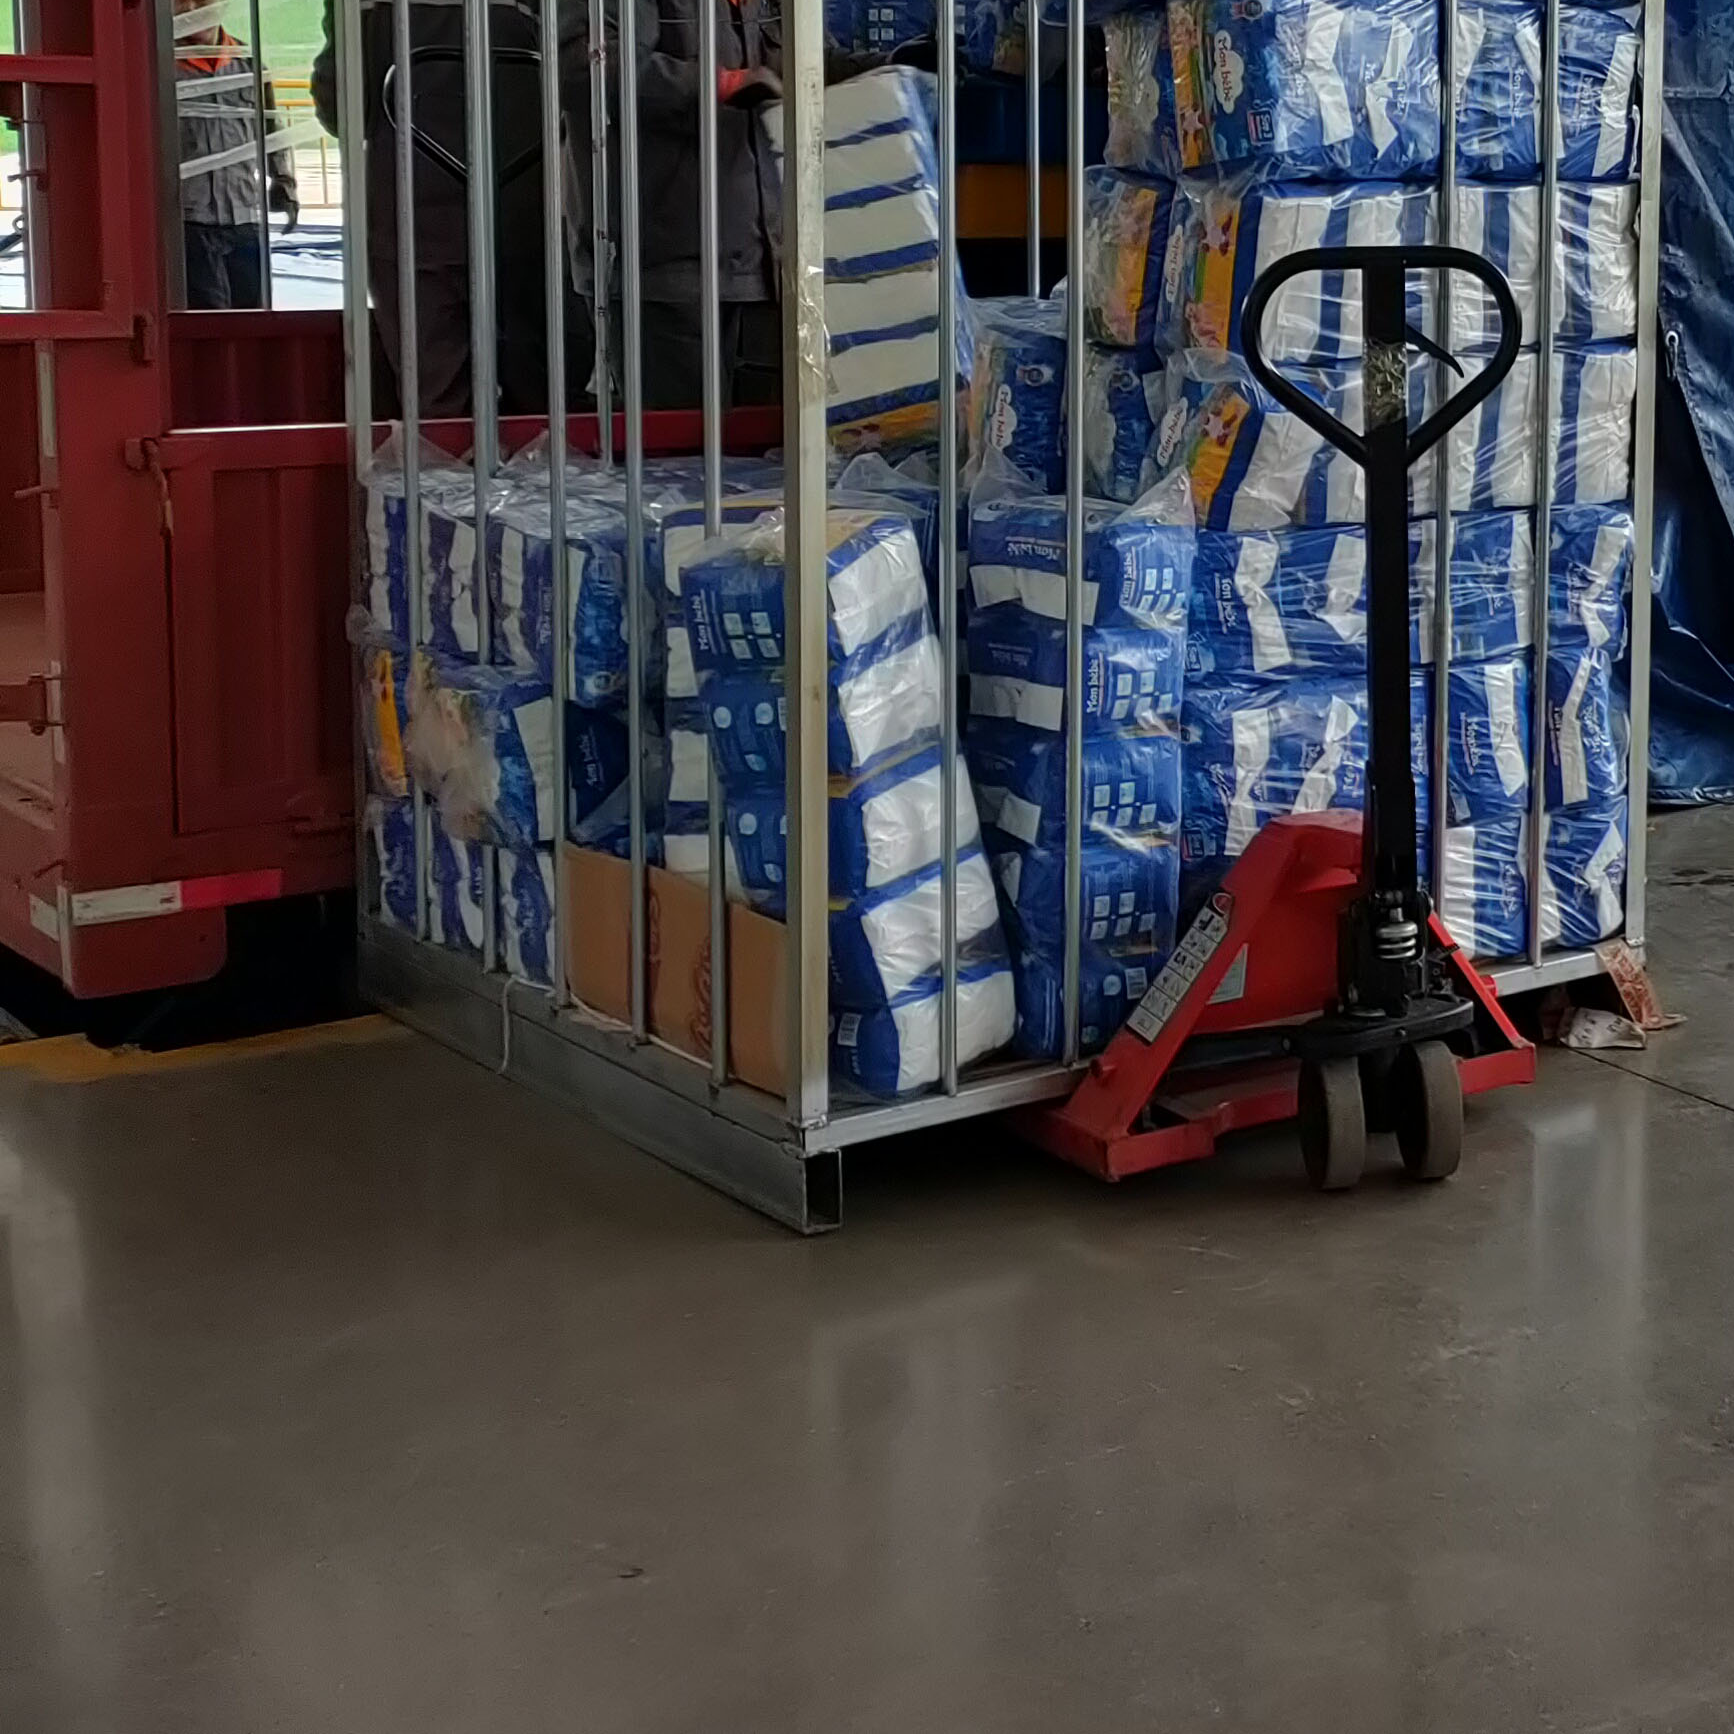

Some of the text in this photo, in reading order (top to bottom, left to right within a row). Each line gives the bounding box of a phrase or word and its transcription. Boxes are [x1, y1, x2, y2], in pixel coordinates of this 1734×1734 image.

[1217, 36, 1228, 68] Mon
[998, 389, 1009, 418] Mon
[1033, 546, 1061, 561] Mon
[695, 624, 709, 651] Mon
[1086, 687, 1099, 714] Mon
